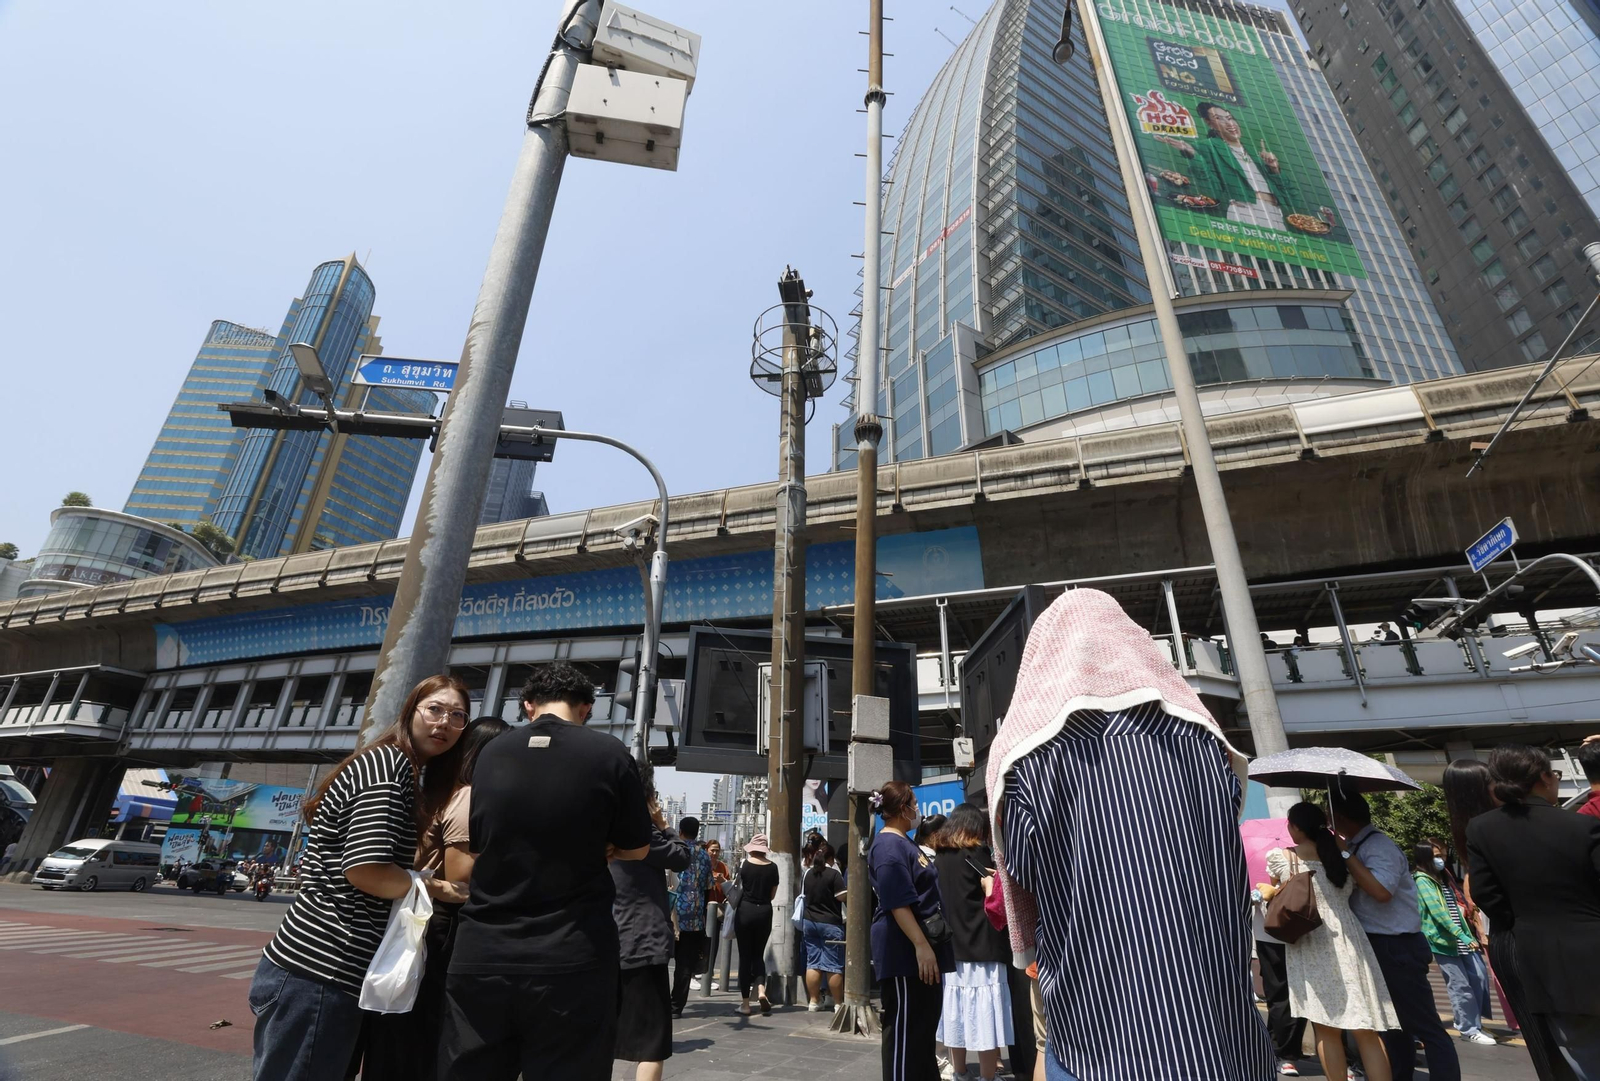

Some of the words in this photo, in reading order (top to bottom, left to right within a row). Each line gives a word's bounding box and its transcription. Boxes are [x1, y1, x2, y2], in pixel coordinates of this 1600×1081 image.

[1097, 3, 1256, 55] GrabFood
[1153, 41, 1194, 59] Grab
[1156, 51, 1198, 70] Food
[1165, 79, 1190, 90] Food
[1146, 112, 1187, 126] HOT
[1152, 124, 1189, 135] DEALS
[1210, 220, 1239, 234] FREE
[1243, 227, 1298, 245] DELIVERY
[1189, 226, 1235, 243] Deliver
[1238, 238, 1278, 252] within
[1300, 249, 1327, 262] mins
[383, 365, 395, 374] ถ.
[401, 364, 453, 379] สุขุมวิท
[381, 377, 425, 386] Sukhumvit
[433, 380, 448, 388] Rd.
[512, 587, 575, 612] ที่ลงตัว
